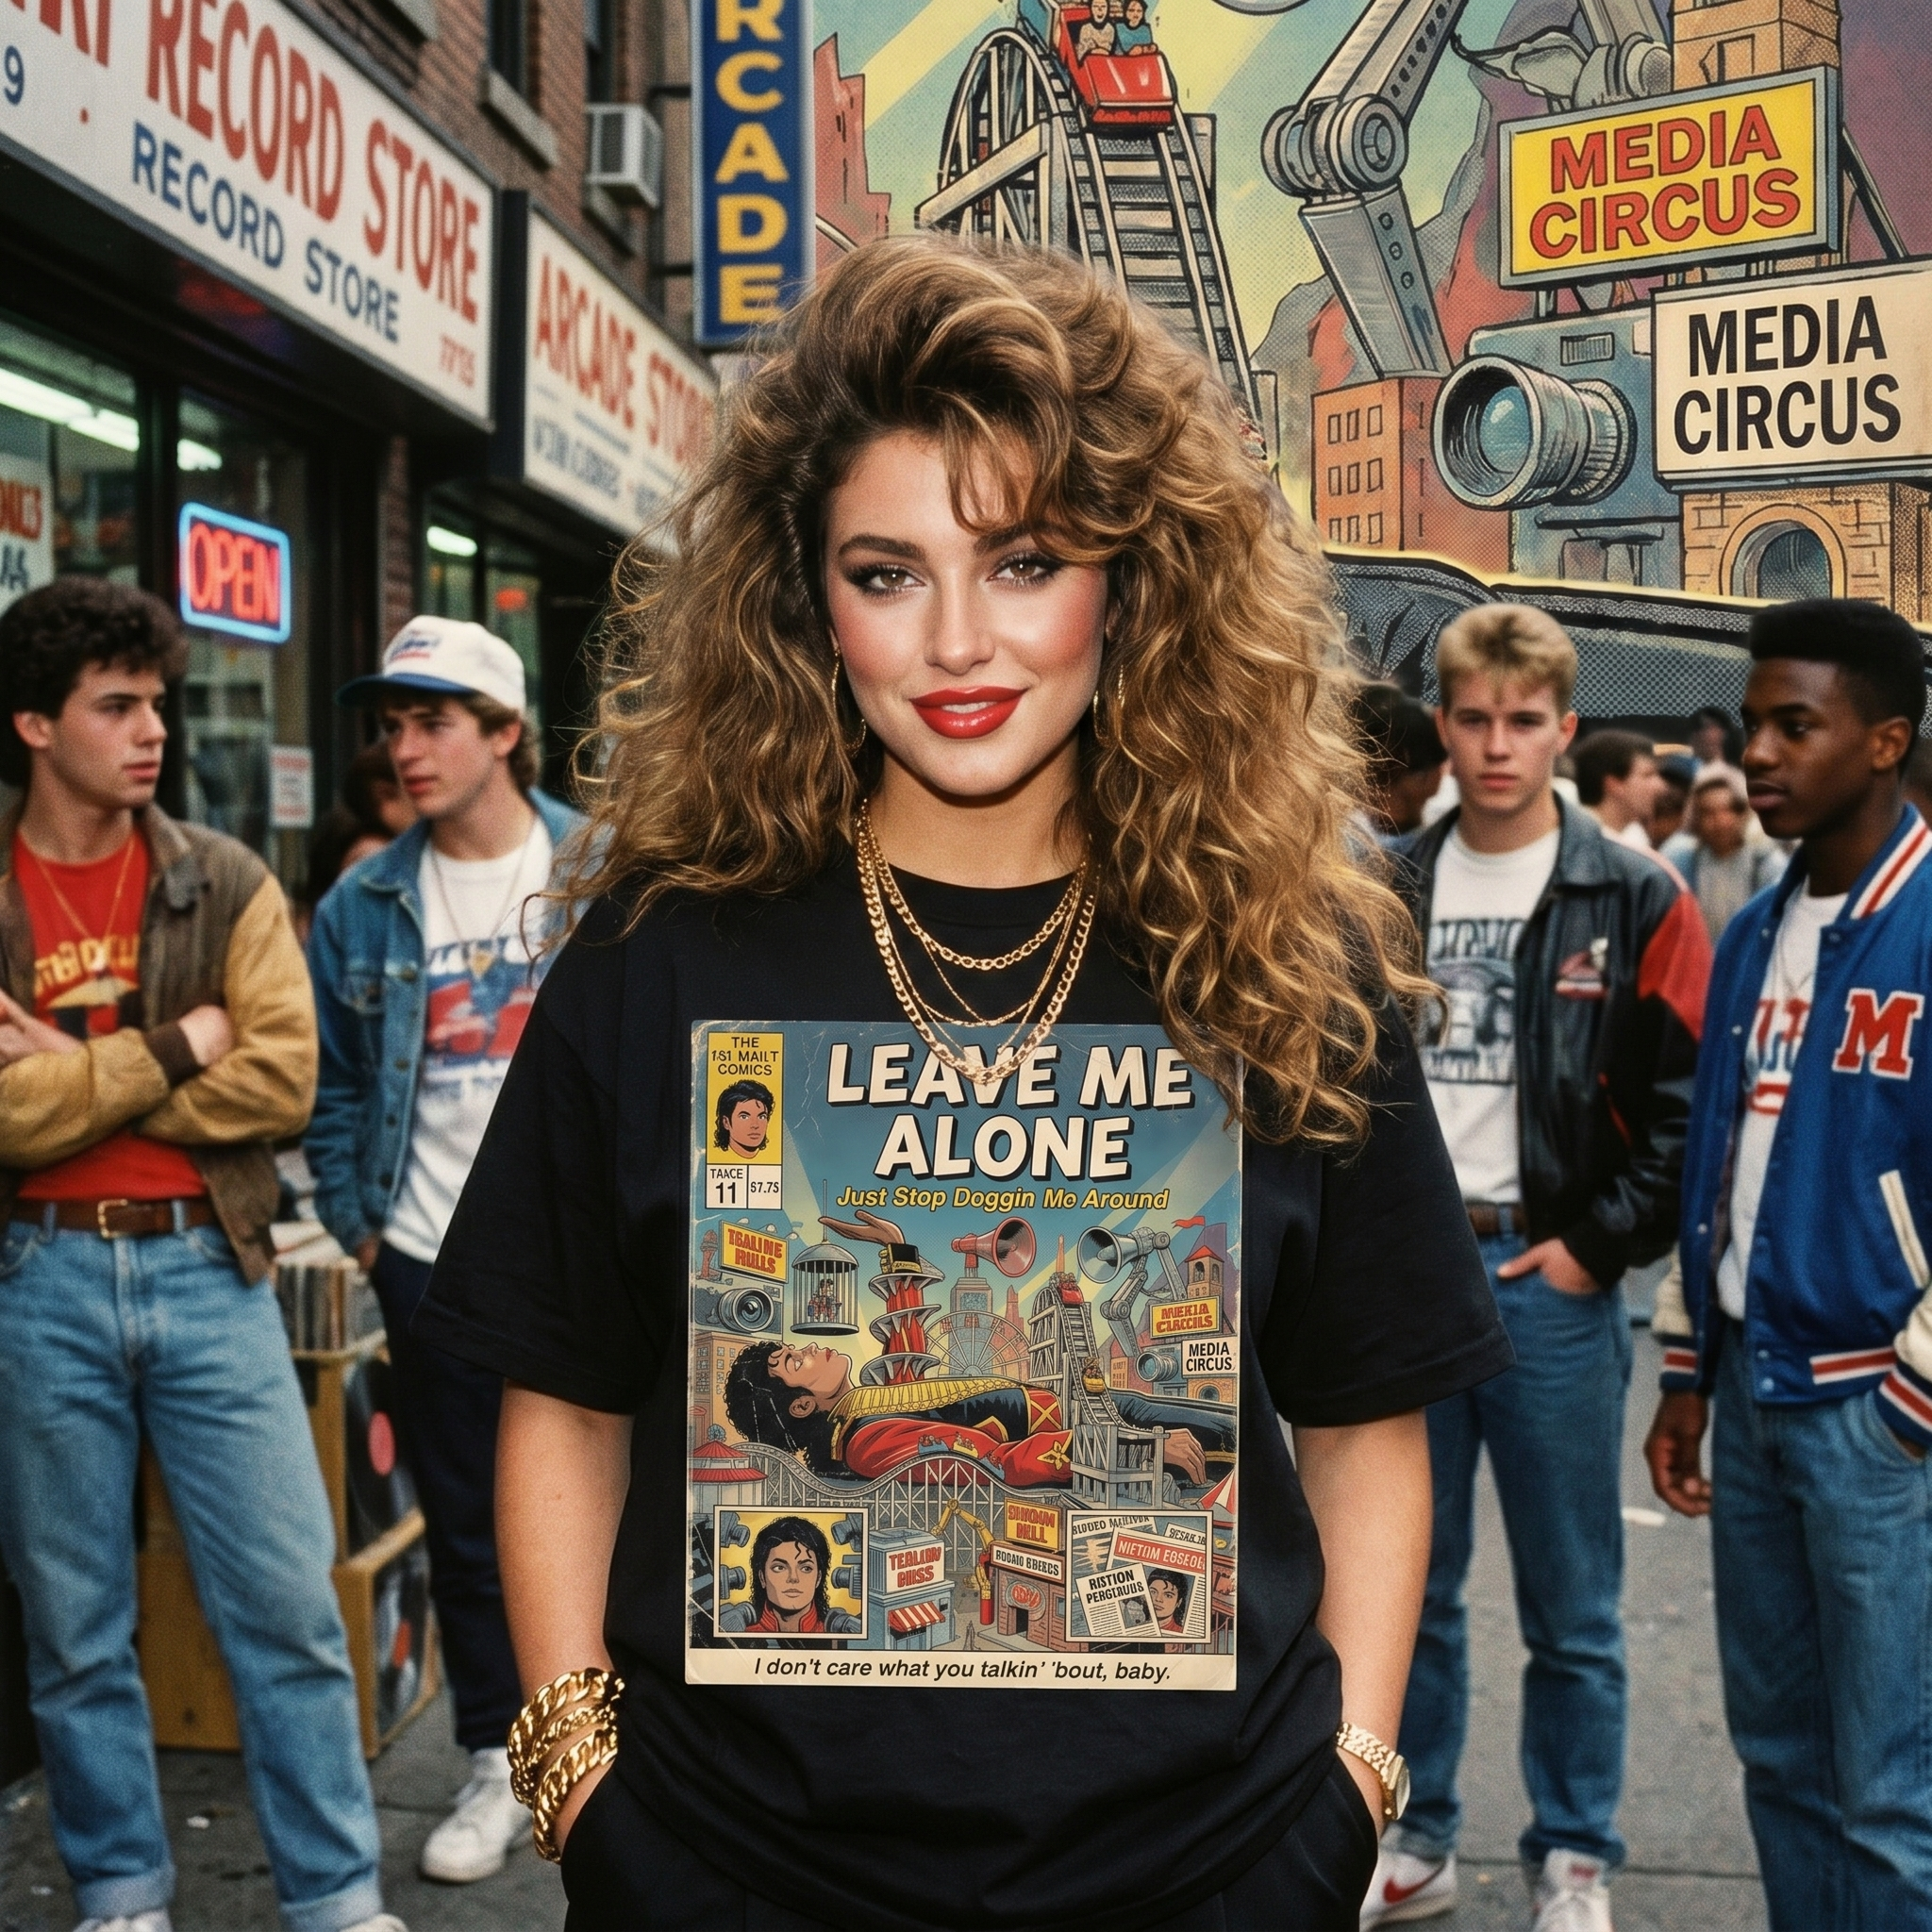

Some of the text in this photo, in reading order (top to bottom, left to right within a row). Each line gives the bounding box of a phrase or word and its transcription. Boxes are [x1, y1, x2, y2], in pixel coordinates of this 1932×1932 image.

[147, 0, 479, 325] RECORD STORE
[1551, 104, 1781, 193] MEDIA
[133, 120, 400, 344] RECORD STORE
[1529, 168, 1801, 259] CIRCUS
[1688, 295, 1888, 377] MEDIA
[1674, 374, 1902, 456] CIRCUS
[189, 521, 280, 625] OPEN
[731, 1036, 760, 1049] THE
[1832, 988, 1924, 1081] M
[717, 1063, 773, 1076] COMICS
[827, 1042, 1196, 1109] LEAVE ME
[874, 1113, 1134, 1182] ALONE
[715, 1181, 736, 1204] 11
[836, 1185, 889, 1208] Just
[891, 1185, 948, 1212] Stop
[952, 1186, 1037, 1214] Doggin
[1079, 1188, 1171, 1210] Around
[1186, 1357, 1232, 1372] CIRCUS
[1189, 1341, 1230, 1357] MEDIA
[755, 1657, 761, 1674] I
[766, 1658, 822, 1676] don't
[825, 1661, 873, 1676] care
[878, 1660, 929, 1677] what
[933, 1663, 974, 1682] you
[1114, 1662, 1171, 1685] baby.
